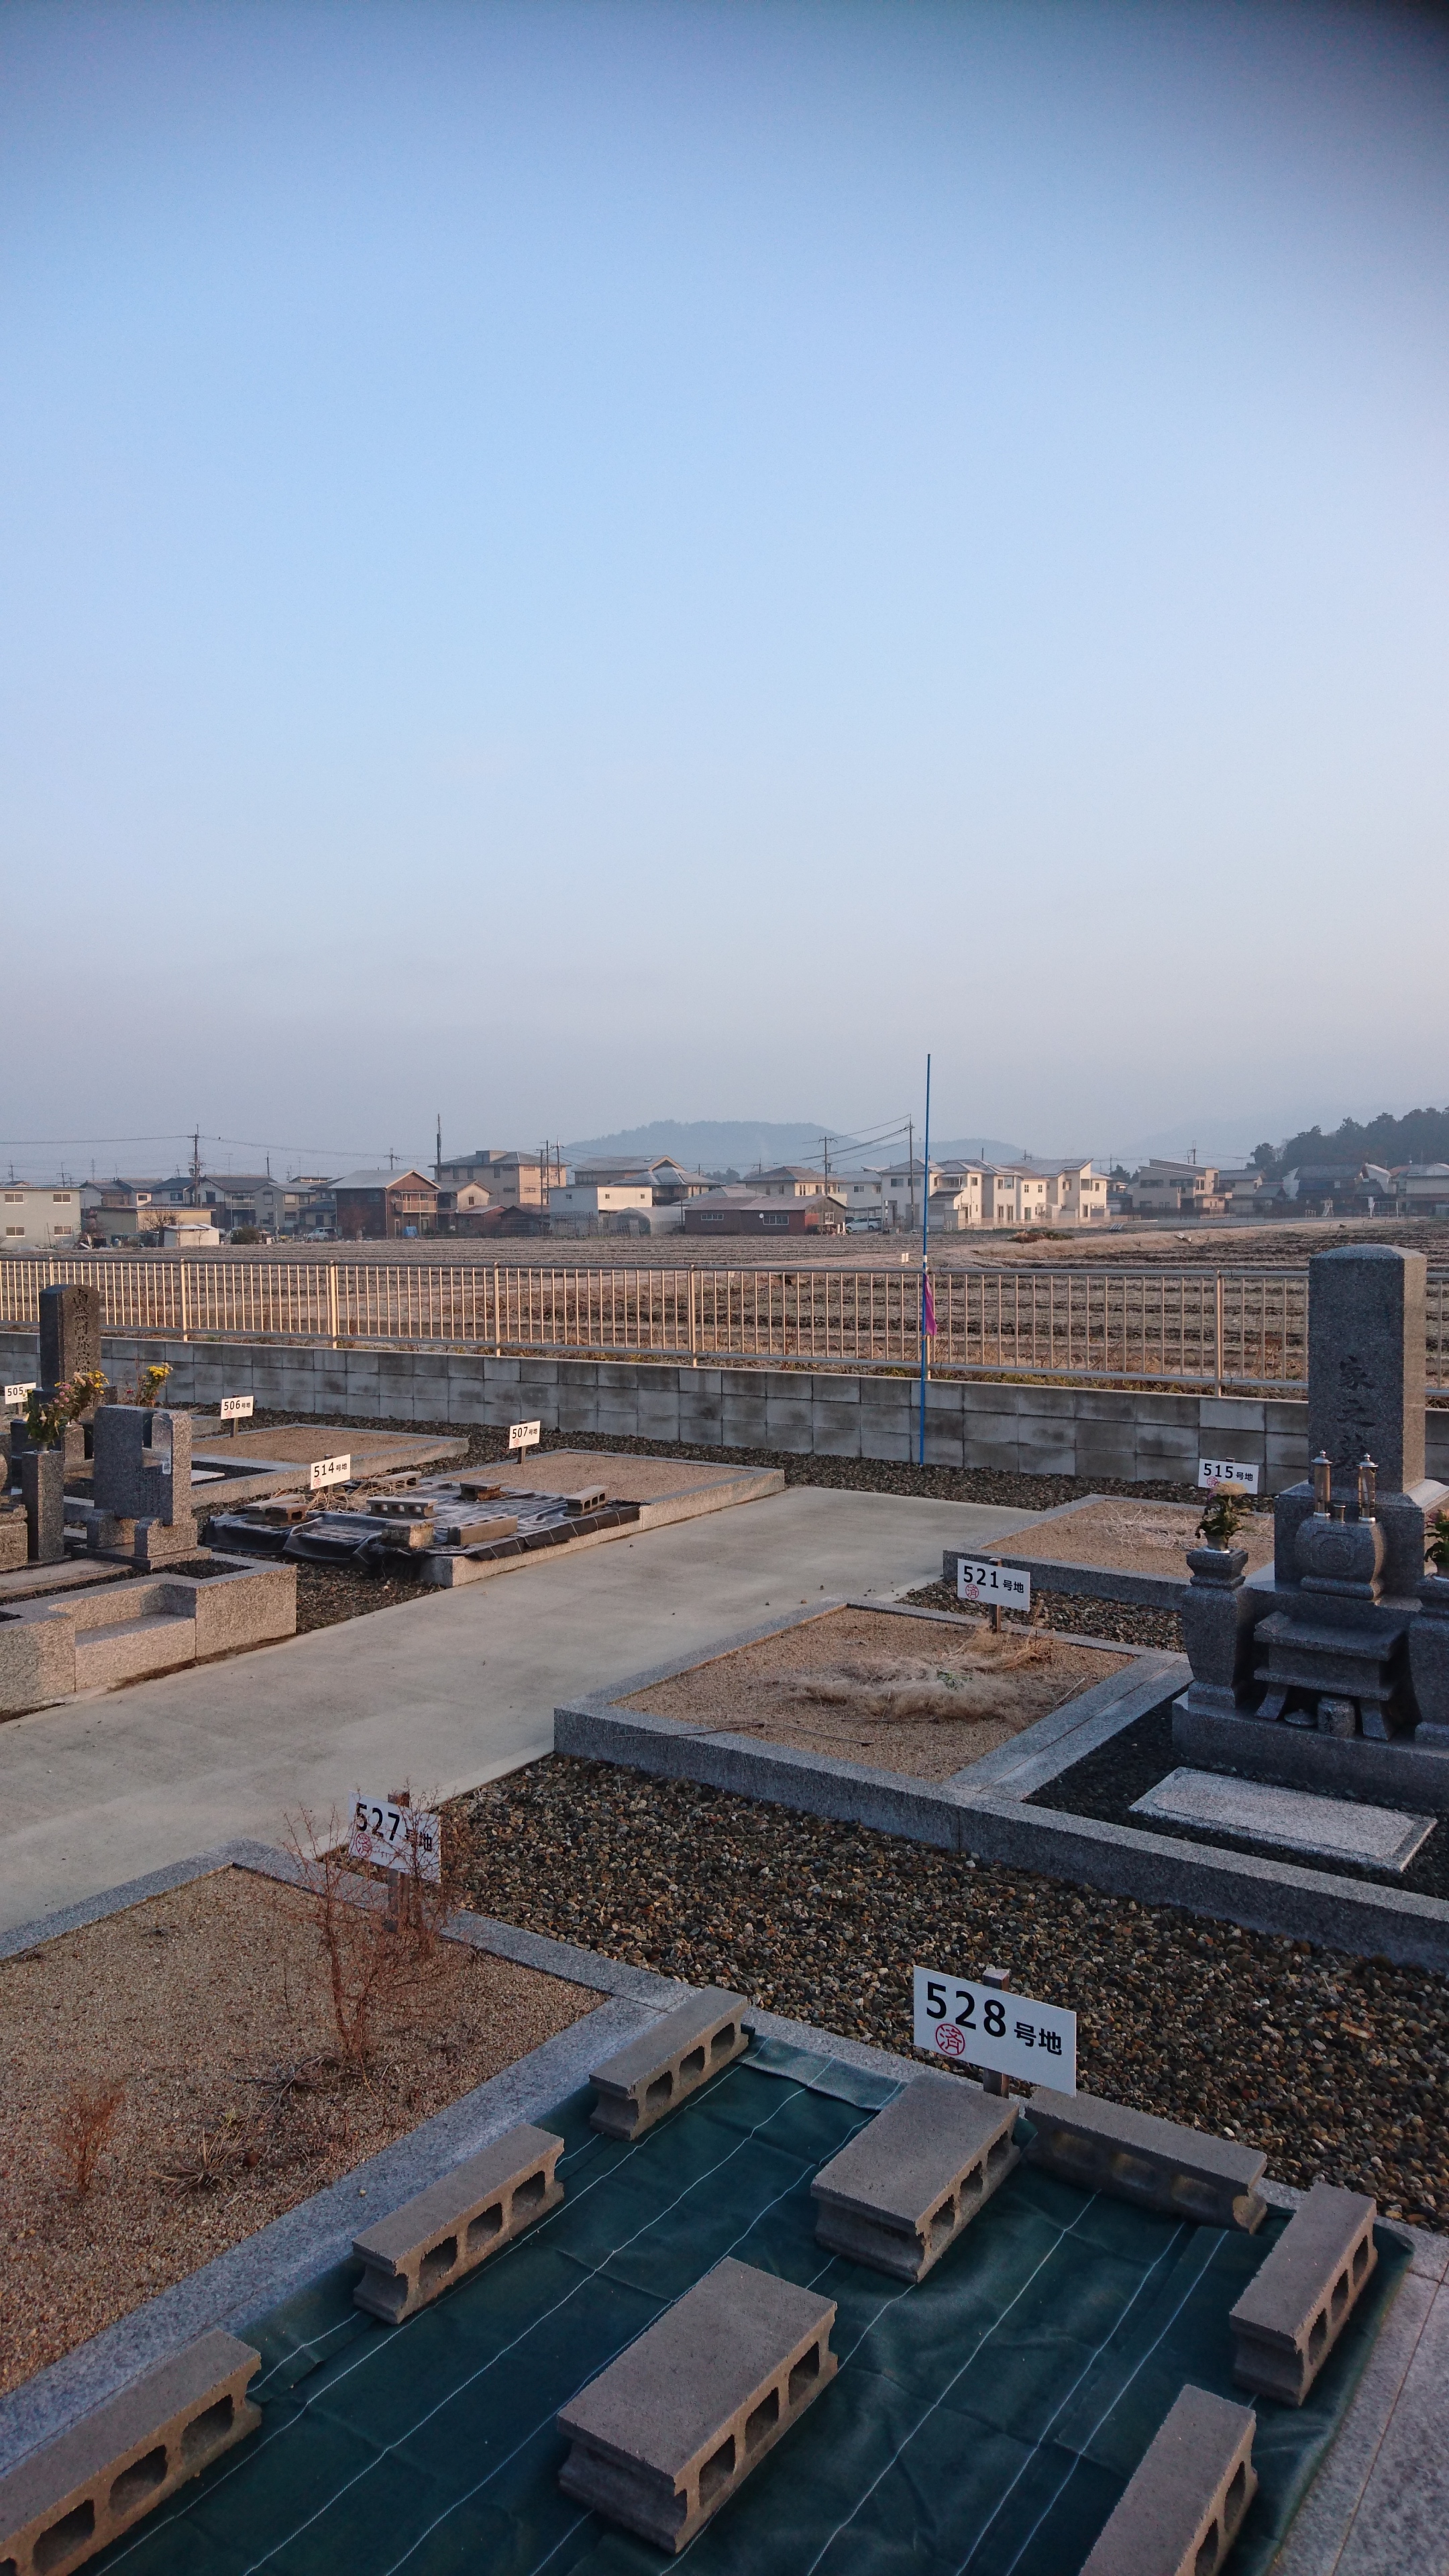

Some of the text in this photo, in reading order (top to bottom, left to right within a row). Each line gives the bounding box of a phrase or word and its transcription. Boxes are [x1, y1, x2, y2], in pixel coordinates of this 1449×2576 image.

[223, 1400, 250, 1411] 506号地
[512, 1426, 537, 1439] 507号地
[314, 1462, 347, 1478] 514号地
[1203, 1463, 1253, 1481] 515号地
[963, 1565, 1024, 1594] 521号地
[966, 1585, 978, 1599] 済
[926, 1981, 1062, 2055] 528号地
[937, 2025, 963, 2055] 済
